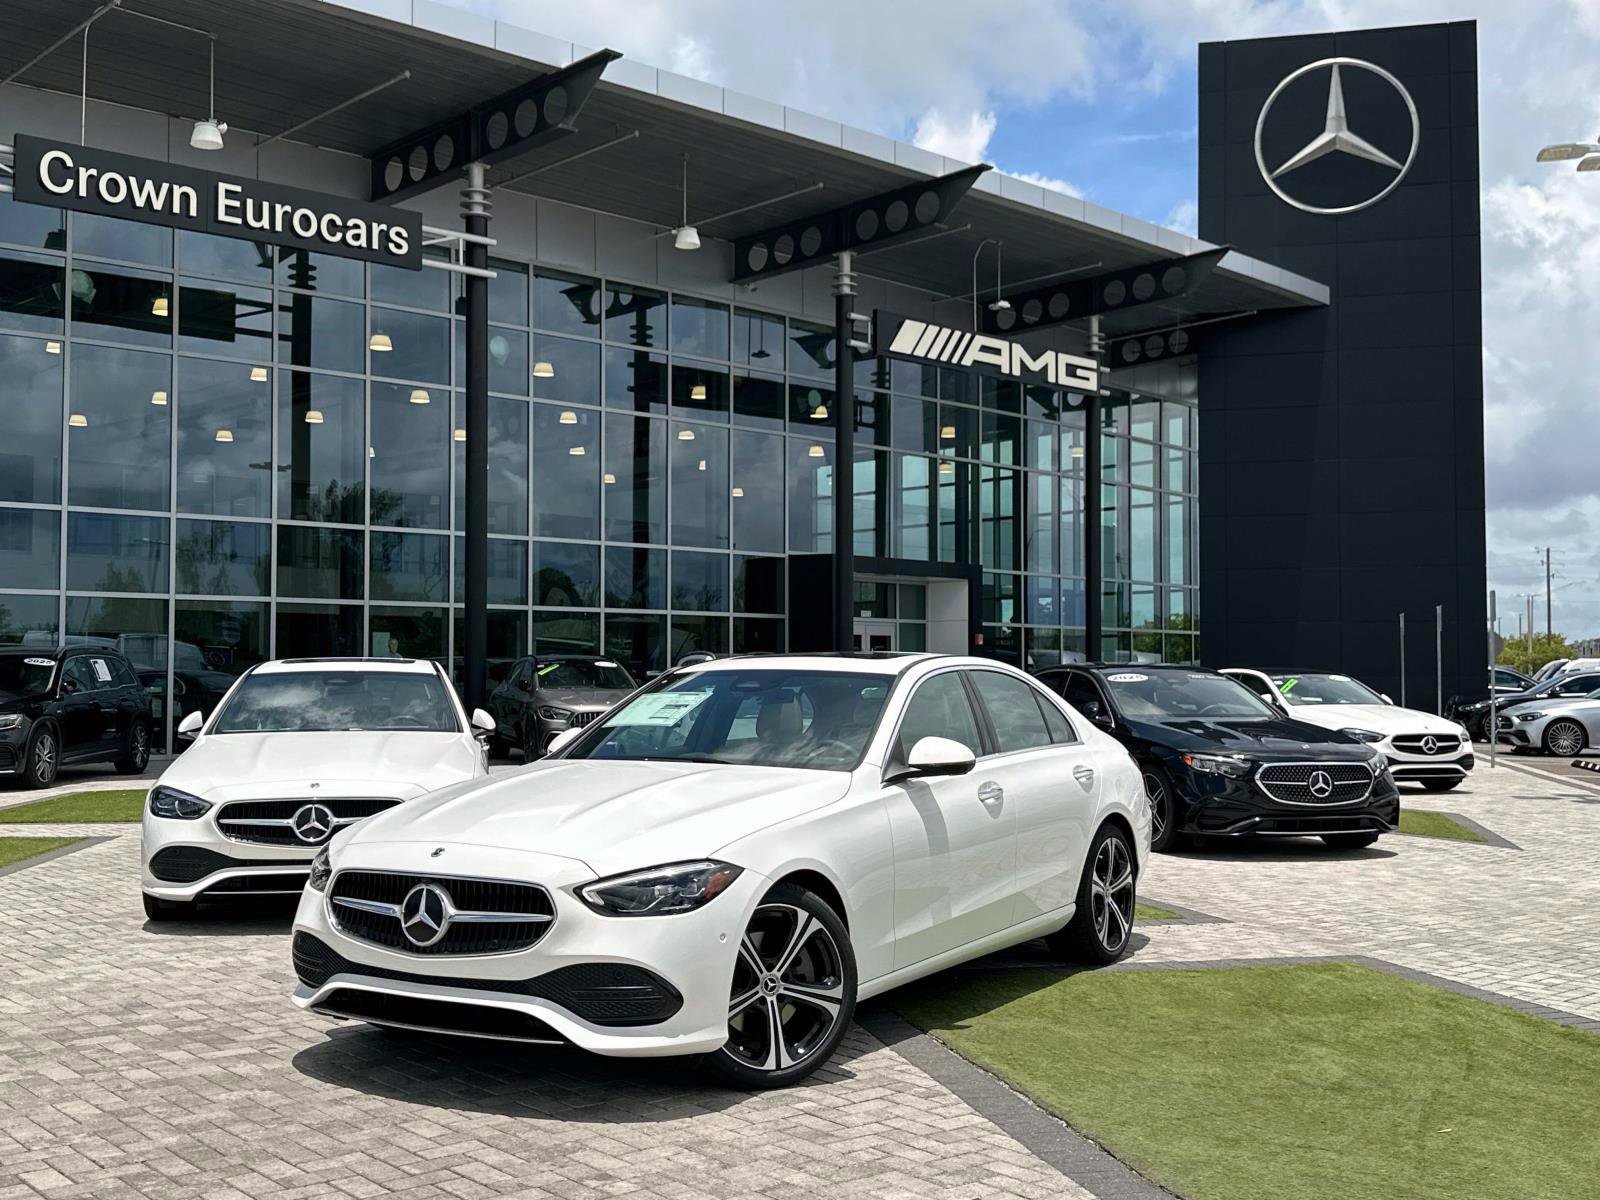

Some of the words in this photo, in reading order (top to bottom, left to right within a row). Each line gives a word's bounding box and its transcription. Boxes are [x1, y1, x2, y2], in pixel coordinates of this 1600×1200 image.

[39, 150, 198, 218] Crown
[217, 182, 410, 256] Eurocars
[960, 334, 1098, 392] AMG
